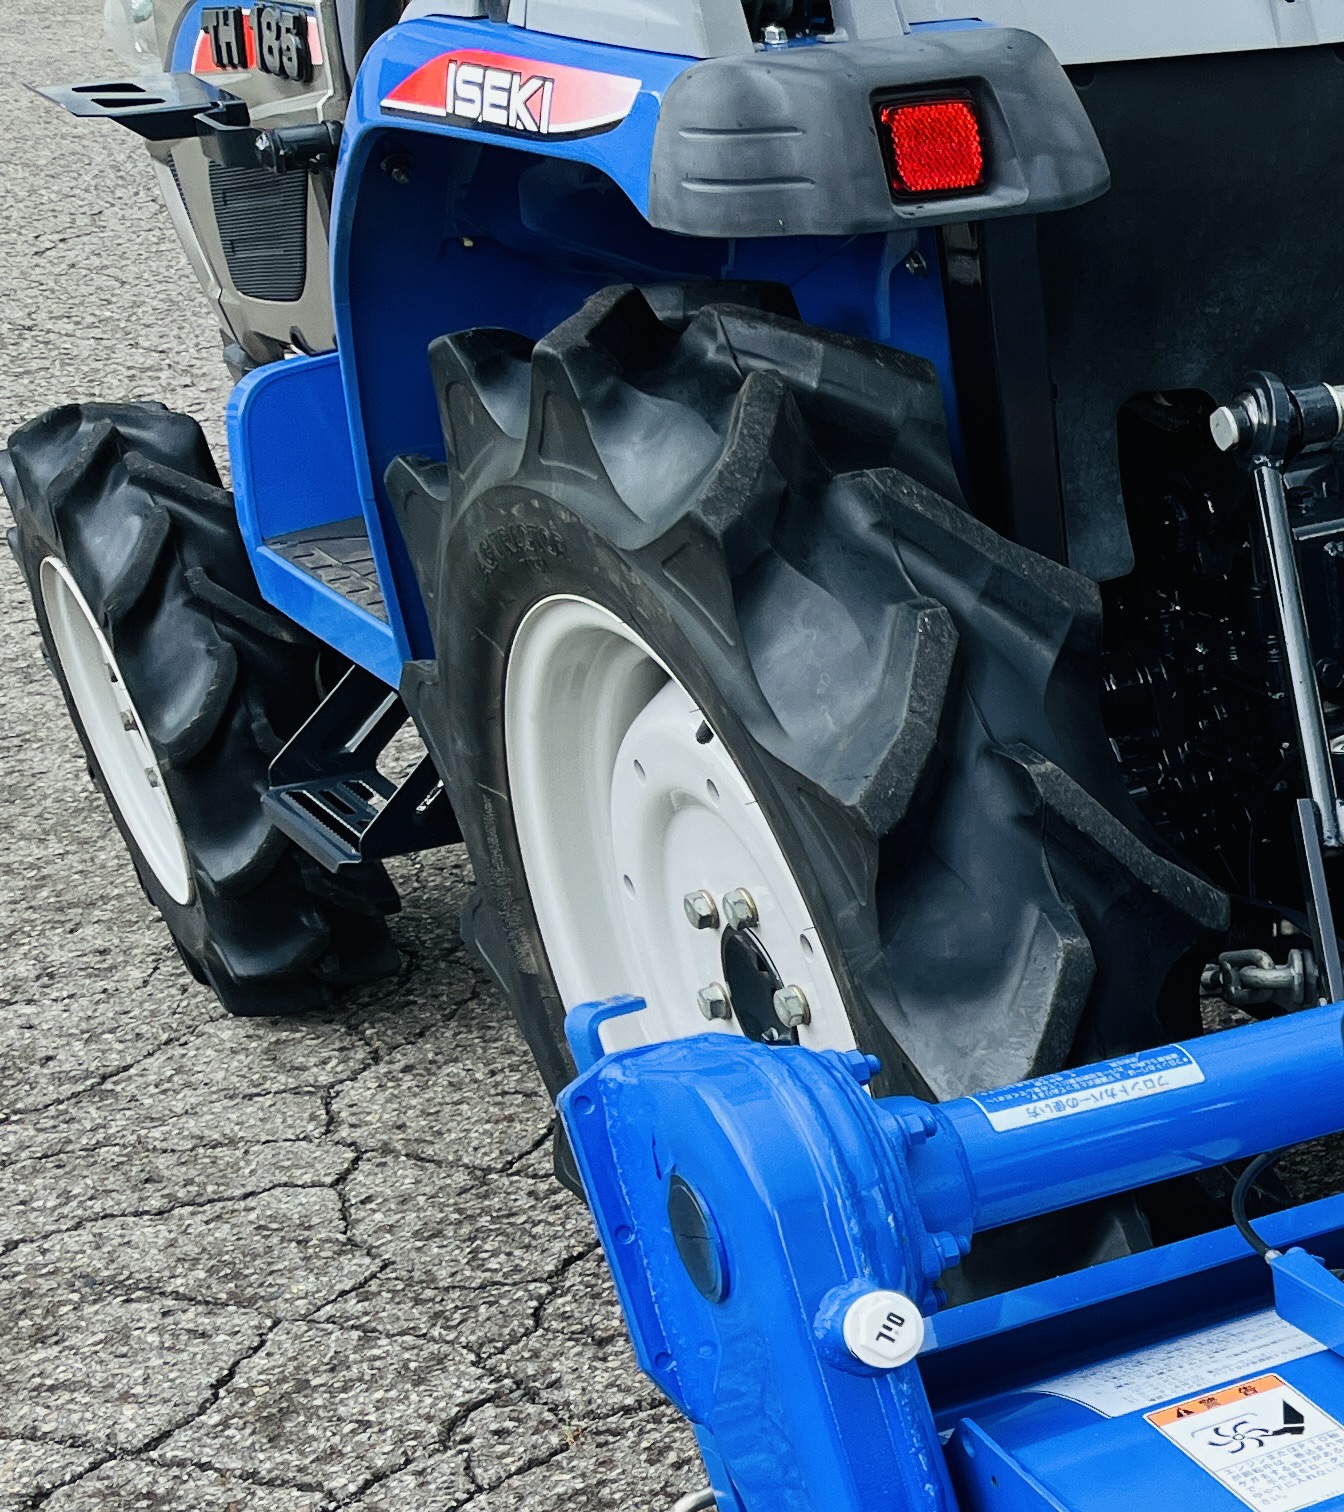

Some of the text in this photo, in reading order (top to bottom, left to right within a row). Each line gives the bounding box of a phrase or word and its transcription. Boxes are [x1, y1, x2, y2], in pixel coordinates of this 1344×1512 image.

[202, 8, 241, 68] TH
[445, 60, 555, 134] ISEKI
[1026, 1075, 1169, 1119] フロントカバーの使い方
